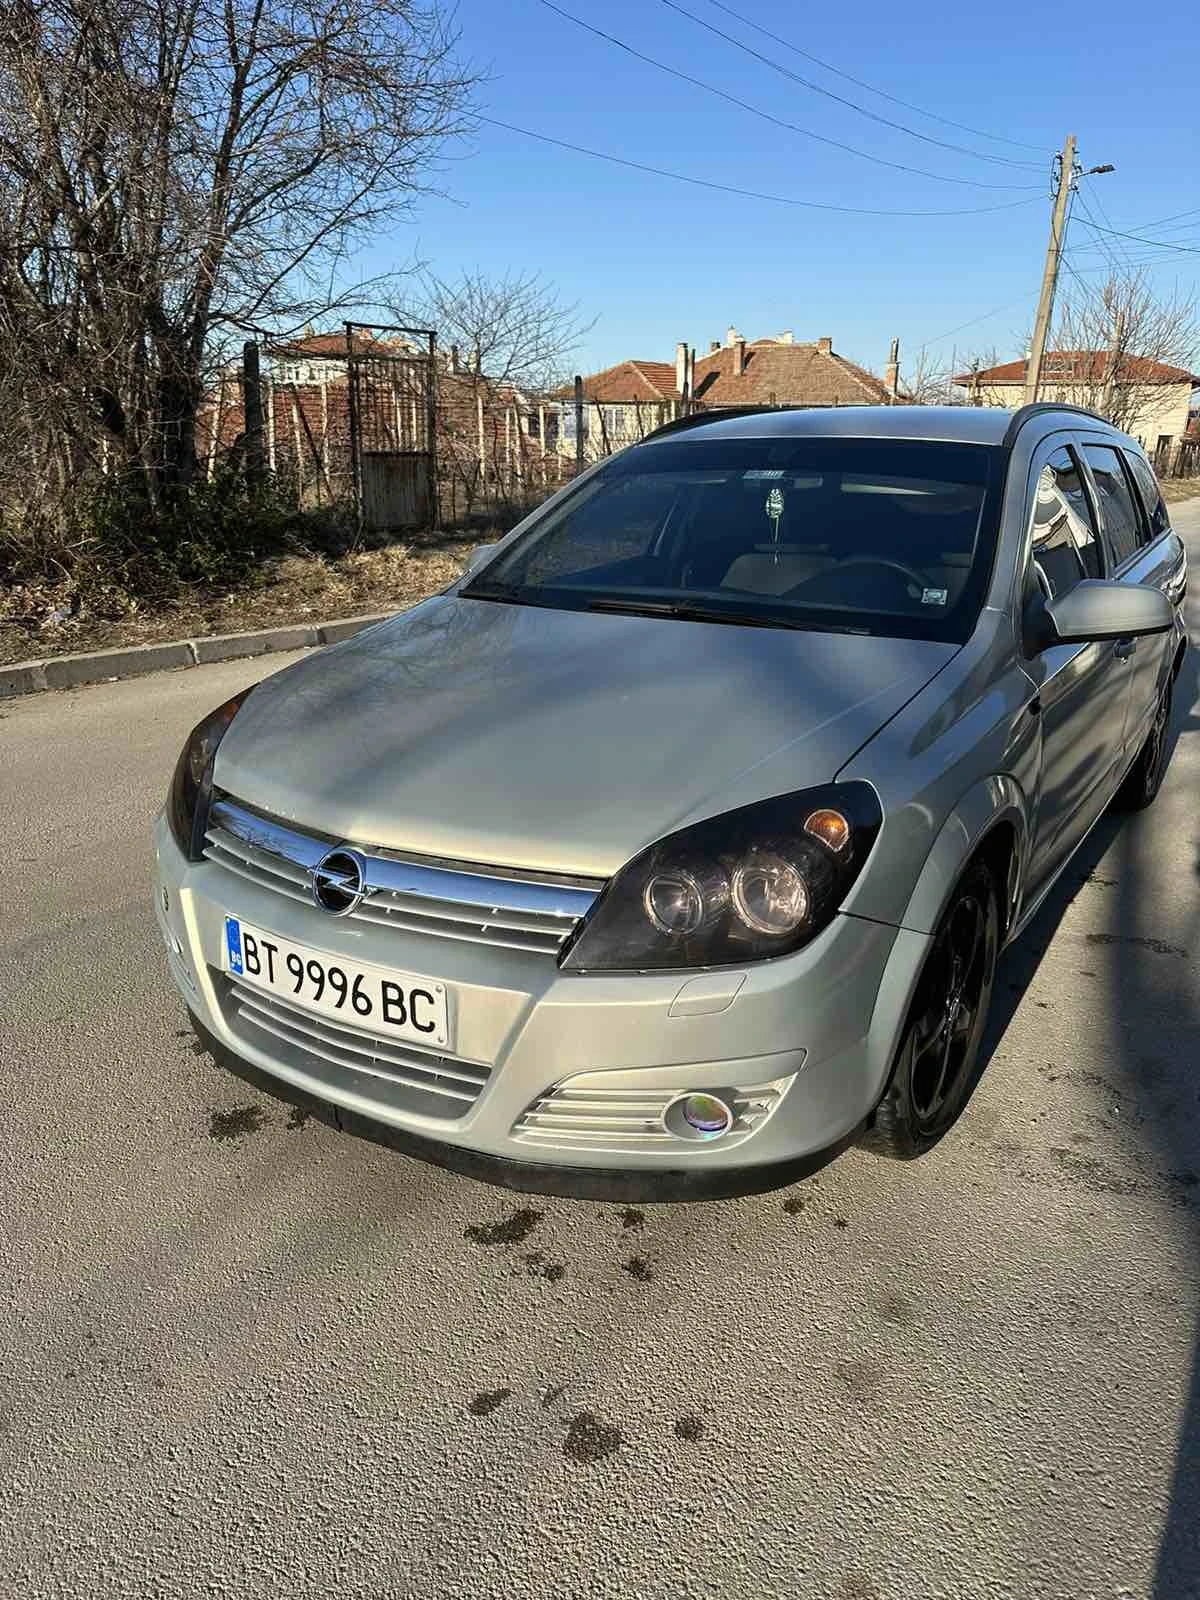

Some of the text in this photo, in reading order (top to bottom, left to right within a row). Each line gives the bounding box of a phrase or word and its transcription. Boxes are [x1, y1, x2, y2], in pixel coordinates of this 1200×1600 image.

[231, 949, 242, 964] BG
[243, 932, 435, 1033] BT 9996 BC
